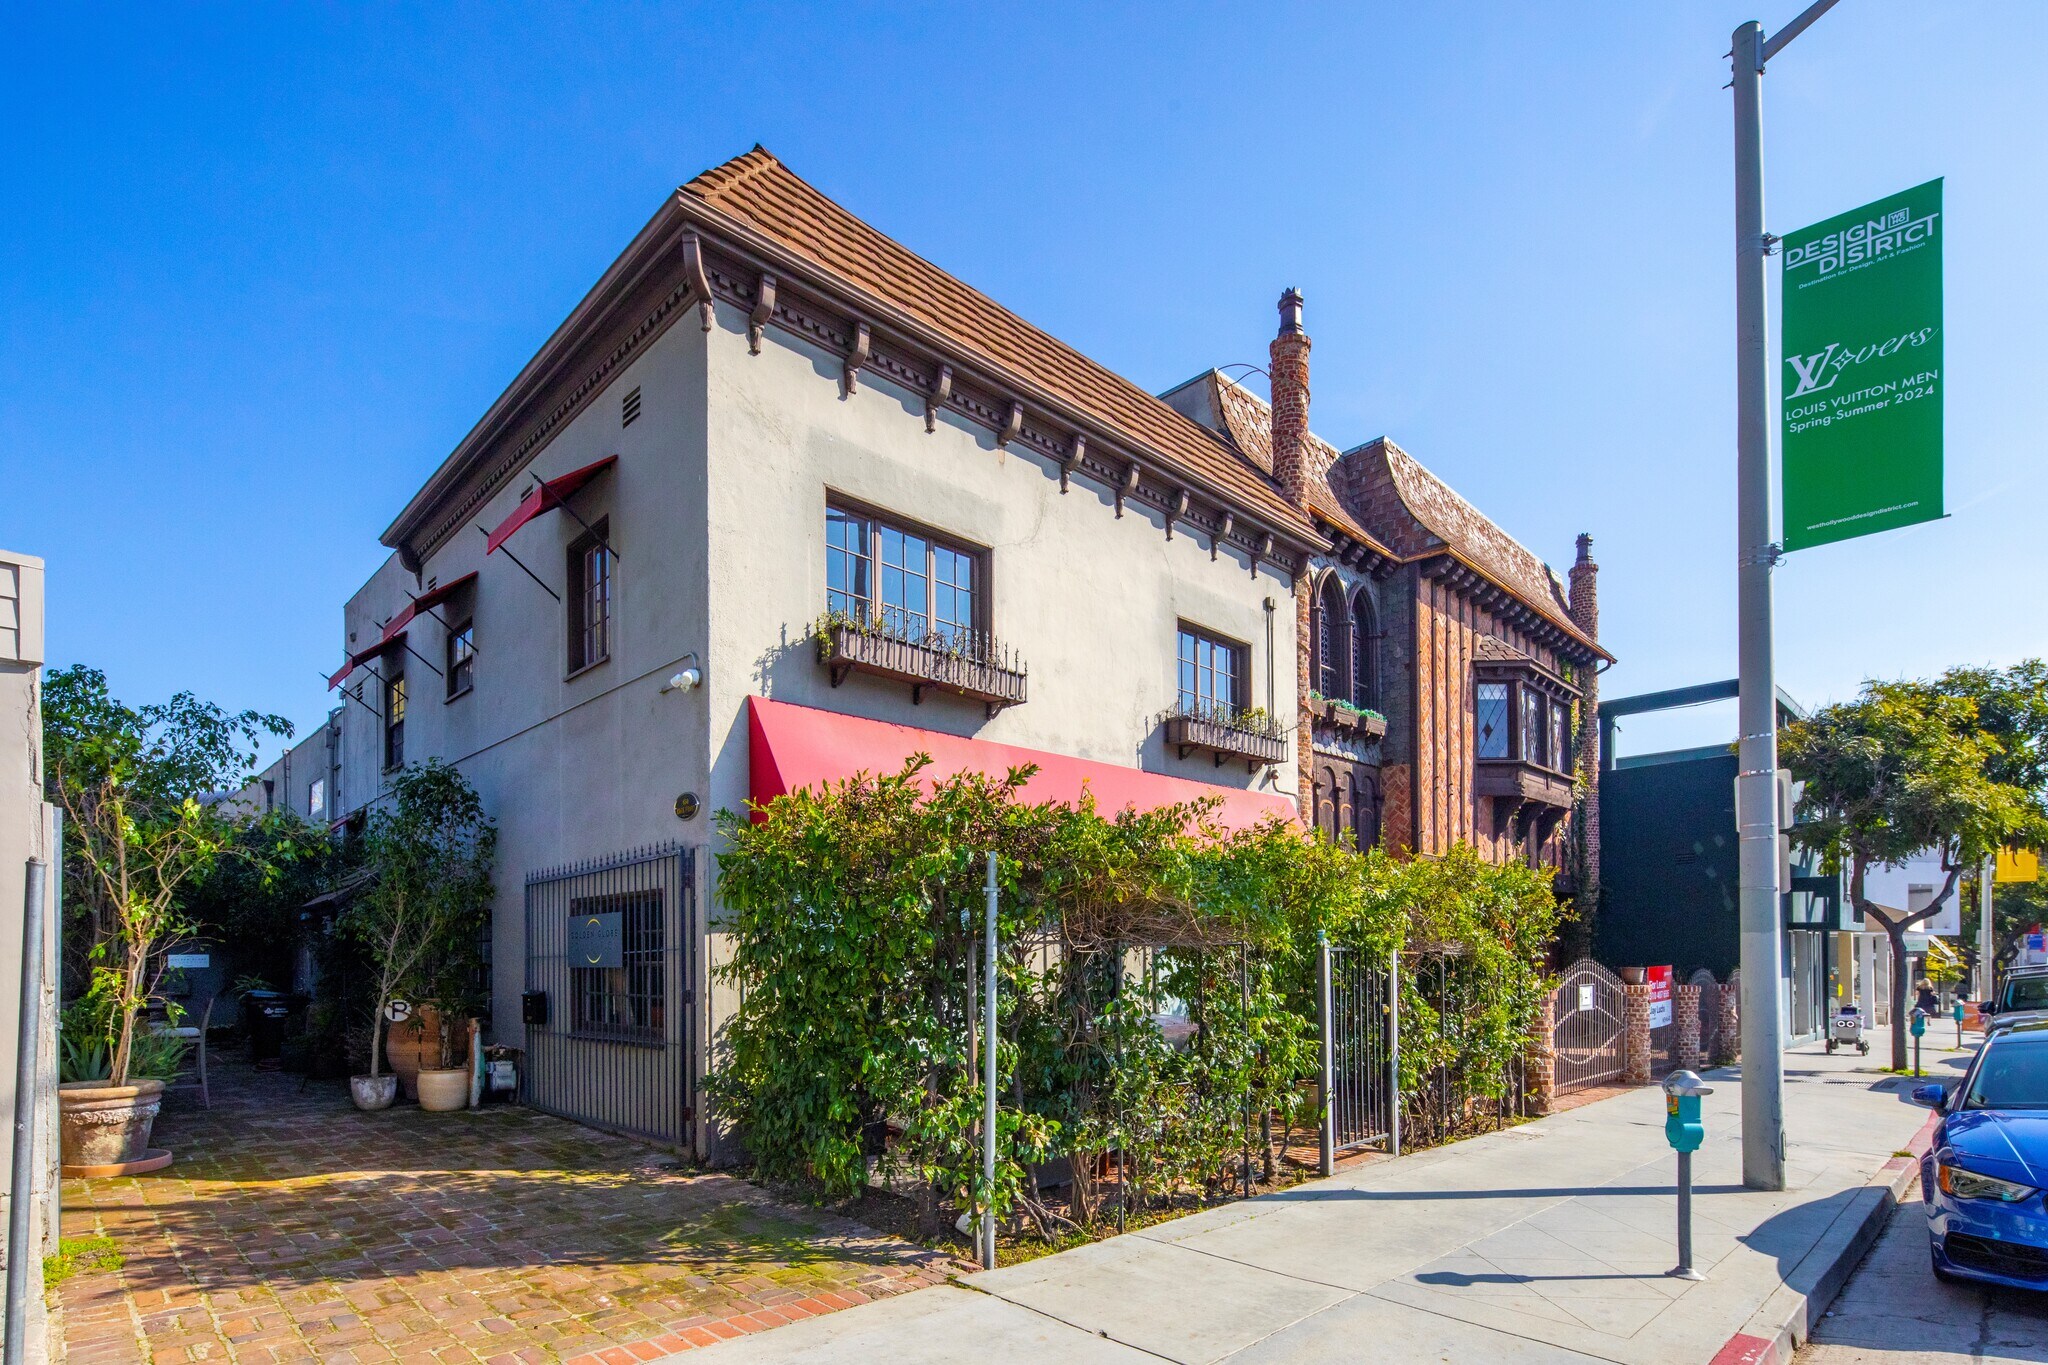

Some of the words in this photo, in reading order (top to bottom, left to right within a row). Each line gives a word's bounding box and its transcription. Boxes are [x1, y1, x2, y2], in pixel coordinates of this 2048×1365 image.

[1786, 215, 1886, 267] DESIGN
[1798, 272, 1837, 290] Destination
[1848, 260, 1875, 273] Design,
[1876, 254, 1888, 262] Art
[1896, 241, 1926, 256] Fashion
[1819, 212, 1939, 275] DISTRICT
[1786, 401, 1827, 421] LOUIS
[1830, 381, 1897, 407] VUITTON
[1901, 369, 1938, 389] MEN
[1789, 399, 1890, 434] Spring-Summer
[1894, 384, 1934, 405] 2024
[1806, 501, 1919, 531] westhollywooddesigndistrict.com
